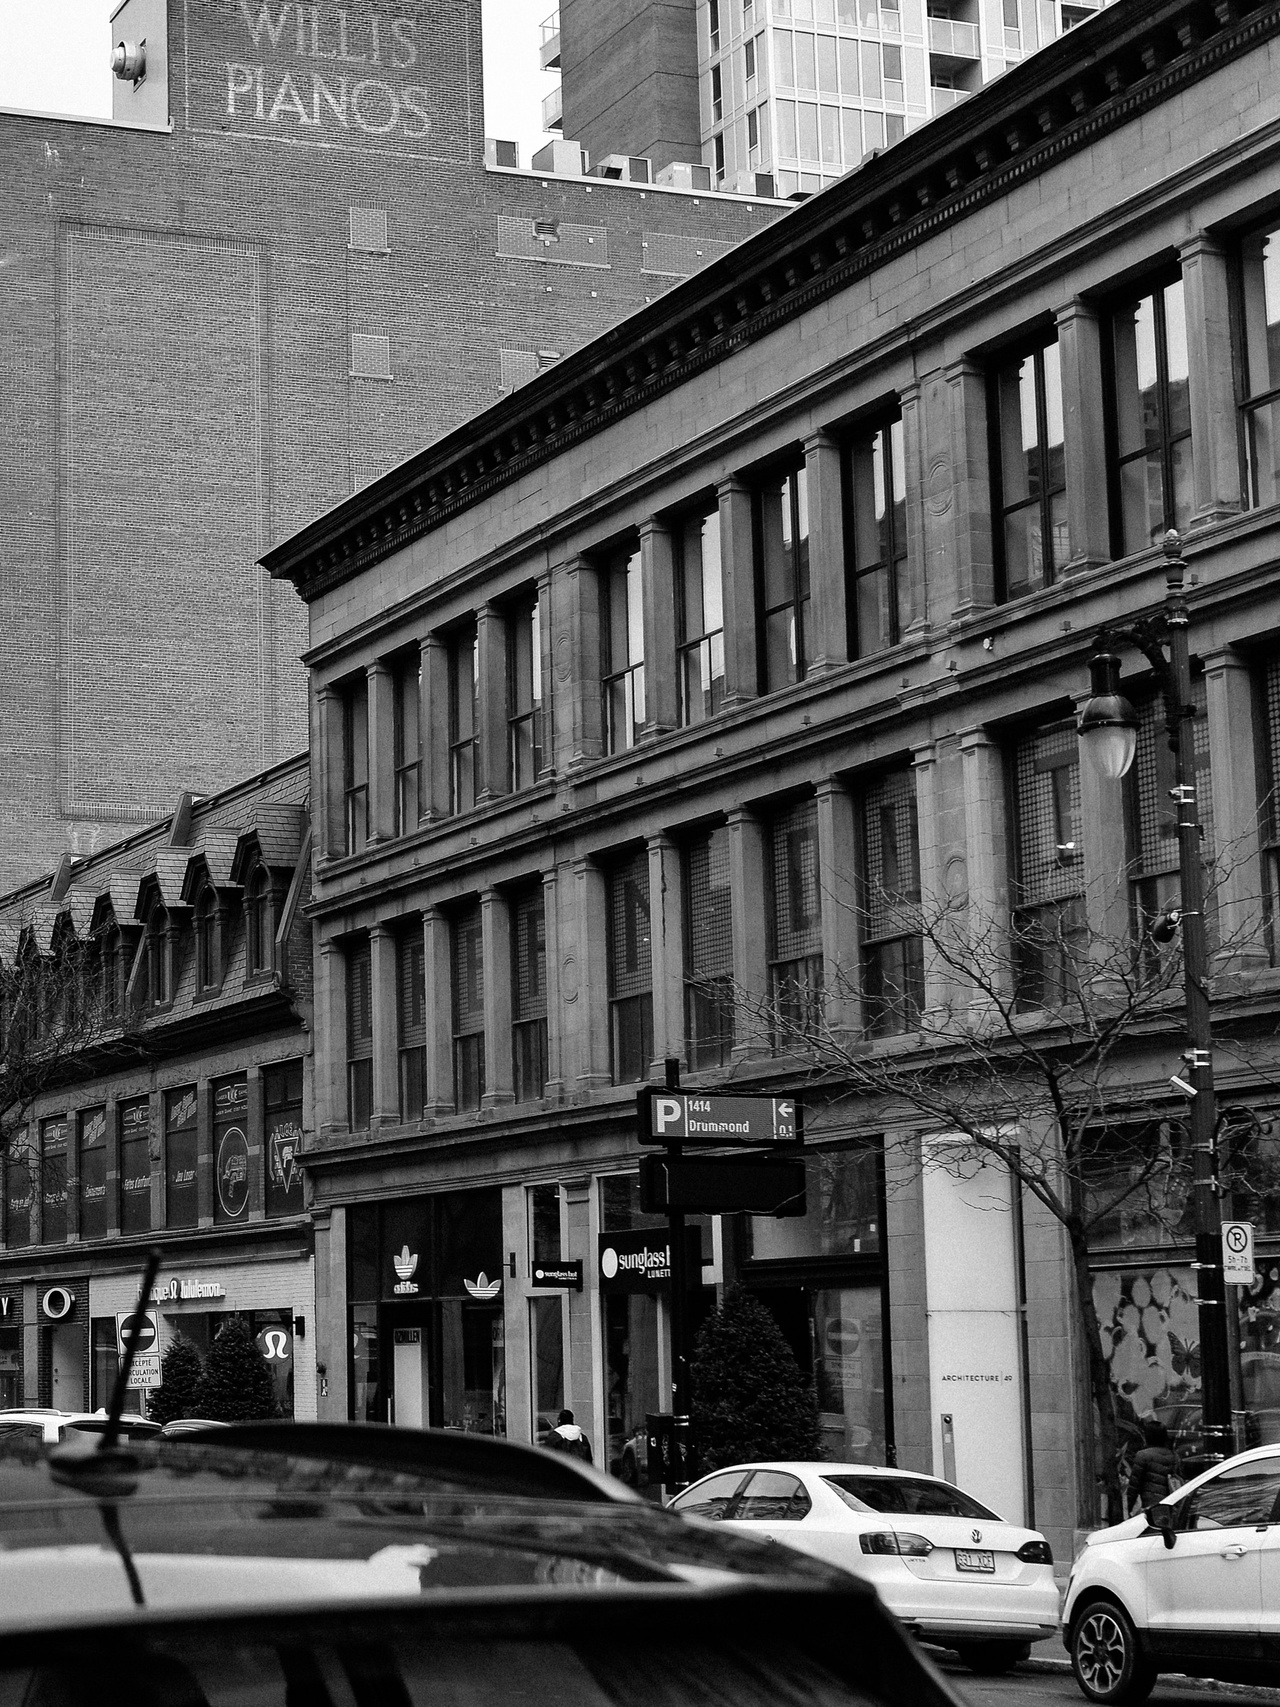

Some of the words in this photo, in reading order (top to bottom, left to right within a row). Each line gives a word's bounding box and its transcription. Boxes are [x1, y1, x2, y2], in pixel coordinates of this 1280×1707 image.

[239, 0, 418, 68] WILLIS
[224, 60, 431, 137] PIANOS
[656, 1099, 682, 1133] P
[688, 1100, 711, 1112] 1414
[689, 1119, 750, 1133] Drummond
[619, 1246, 665, 1274] sunglass
[647, 1268, 671, 1279] LUNETT
[180, 1279, 221, 1299] lululemon
[131, 1358, 151, 1367] CEPTÉ
[129, 1368, 159, 1376] RCULATION
[131, 1377, 151, 1385] LOCALE
